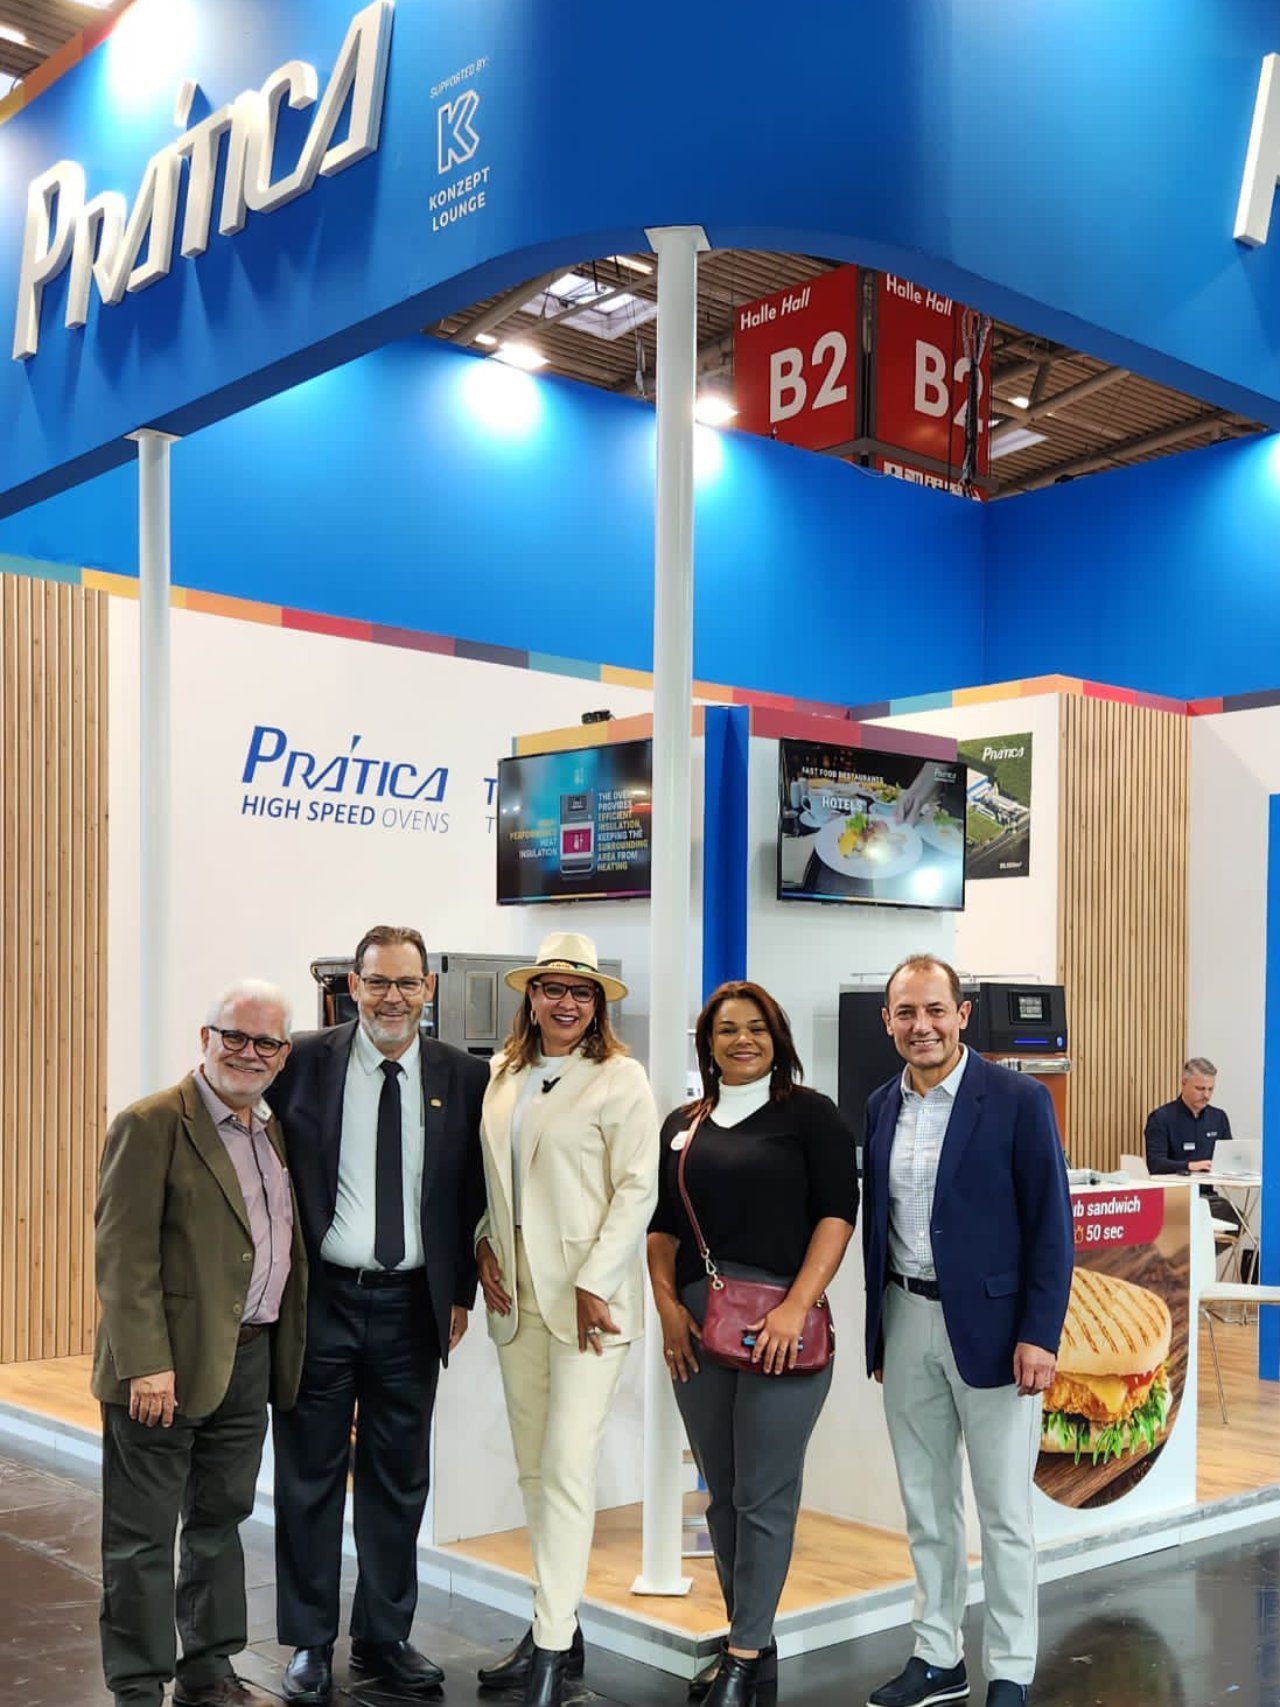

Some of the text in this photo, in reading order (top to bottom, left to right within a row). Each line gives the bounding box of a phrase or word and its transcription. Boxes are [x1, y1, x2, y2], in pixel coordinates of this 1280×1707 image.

[429, 65, 474, 98] SUPPORTED
[429, 166, 490, 211] KONZEPT
[432, 192, 486, 232] LOUNGE
[740, 287, 810, 331] Halle Hall
[886, 273, 953, 317] Halle Hall
[769, 331, 847, 424] B2
[915, 339, 983, 433] B2
[820, 769, 837, 779] FOOD
[241, 795, 449, 834] HIGH SPEED OVENS
[1087, 1195, 1141, 1217] sandwich
[1086, 1224, 1124, 1242] 50 sec
